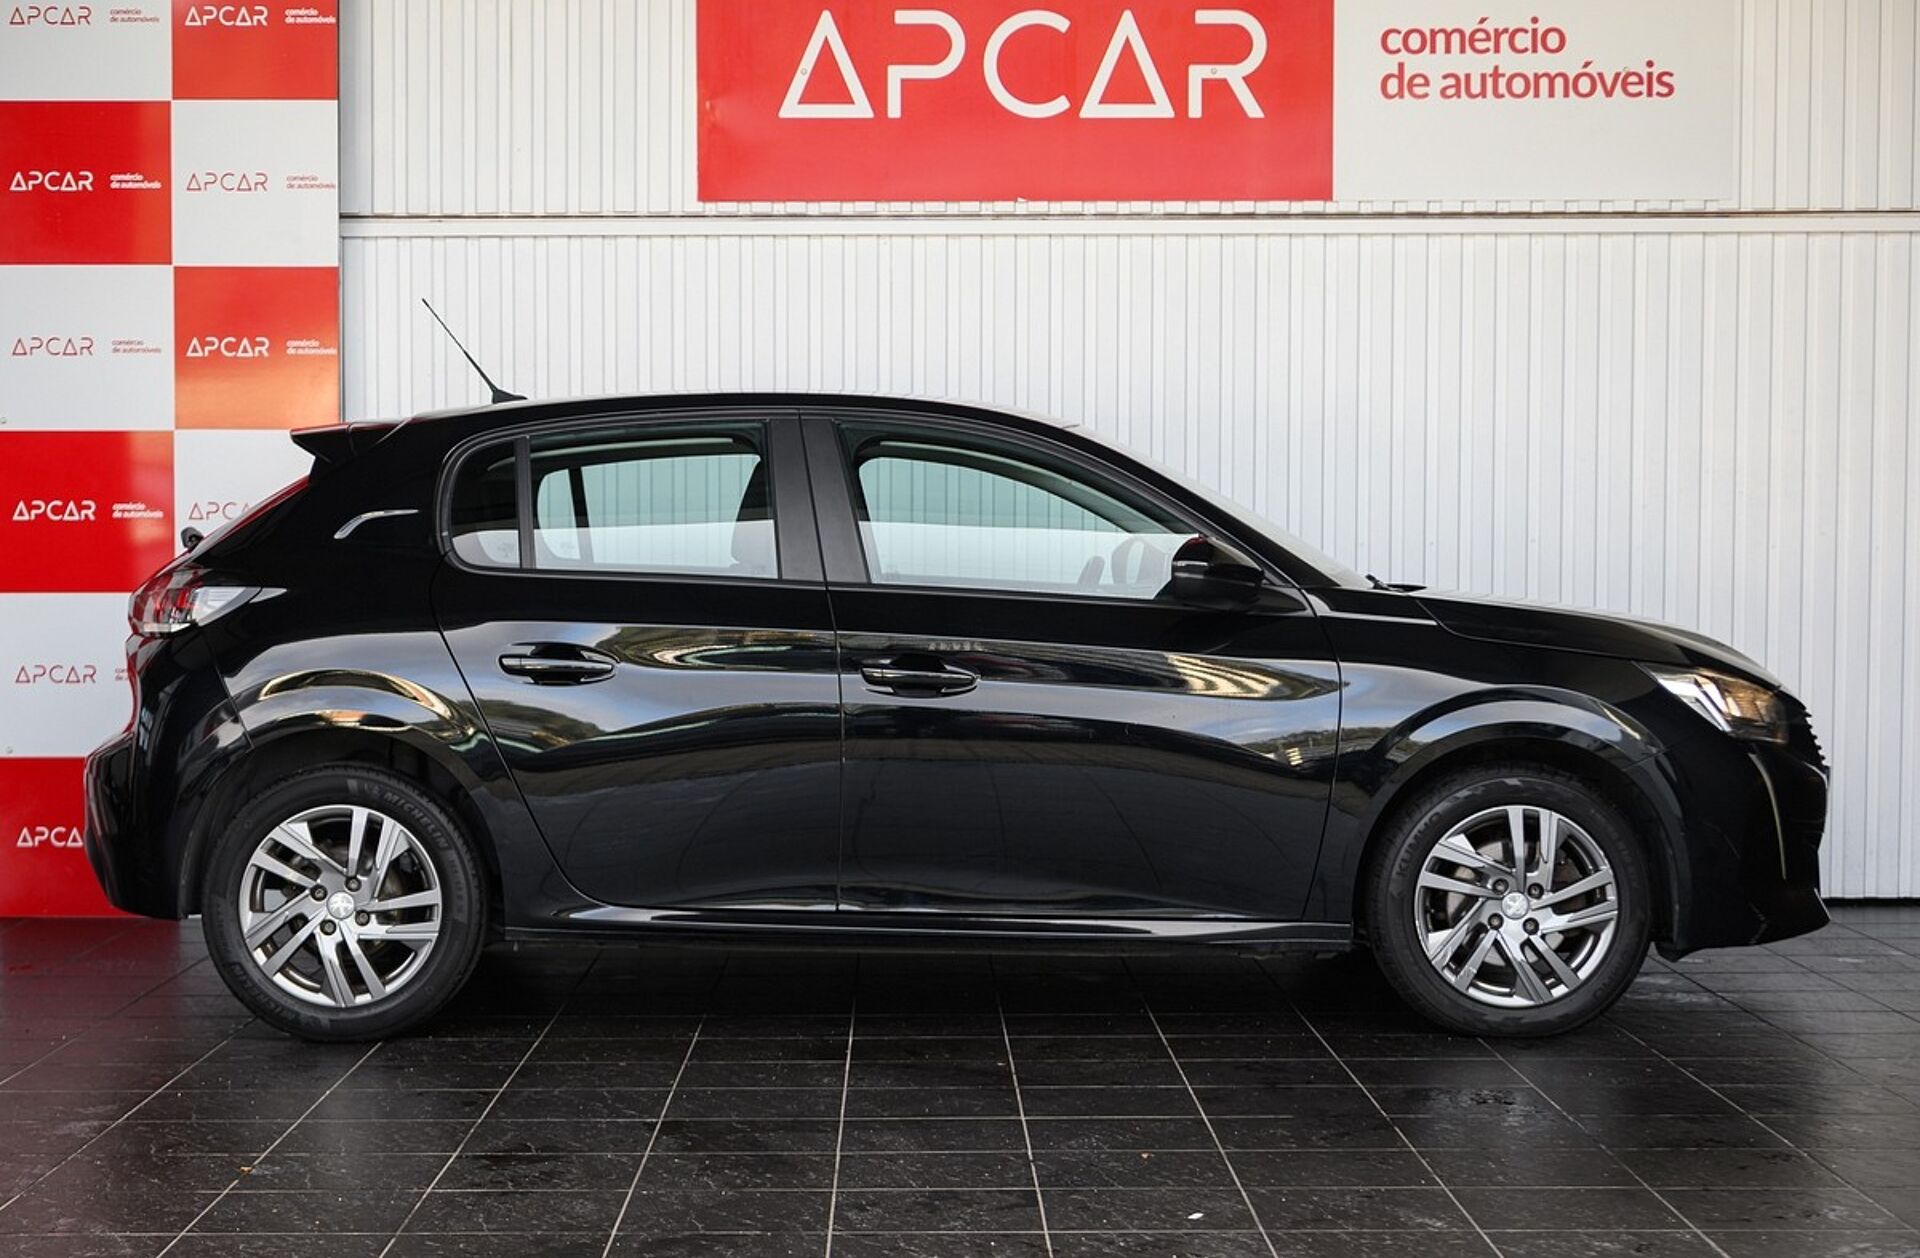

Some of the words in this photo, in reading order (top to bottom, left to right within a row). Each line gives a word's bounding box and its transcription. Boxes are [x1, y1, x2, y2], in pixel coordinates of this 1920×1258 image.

[9, 5, 92, 25] APCAR
[184, 5, 268, 26] APCAR
[1380, 15, 1566, 56] comércio
[778, 8, 1267, 119] APCAR
[1380, 61, 1430, 100] de
[1439, 59, 1676, 100] automóveis
[10, 171, 94, 191] APCAR
[186, 172, 268, 192] APCAR
[12, 337, 94, 356] APCAR
[185, 336, 270, 357] APCAR
[12, 500, 96, 521] APCAR
[188, 501, 248, 520] APC
[15, 665, 97, 684] APCAR
[383, 791, 450, 850] MICHELIN
[18, 826, 84, 848] APCA
